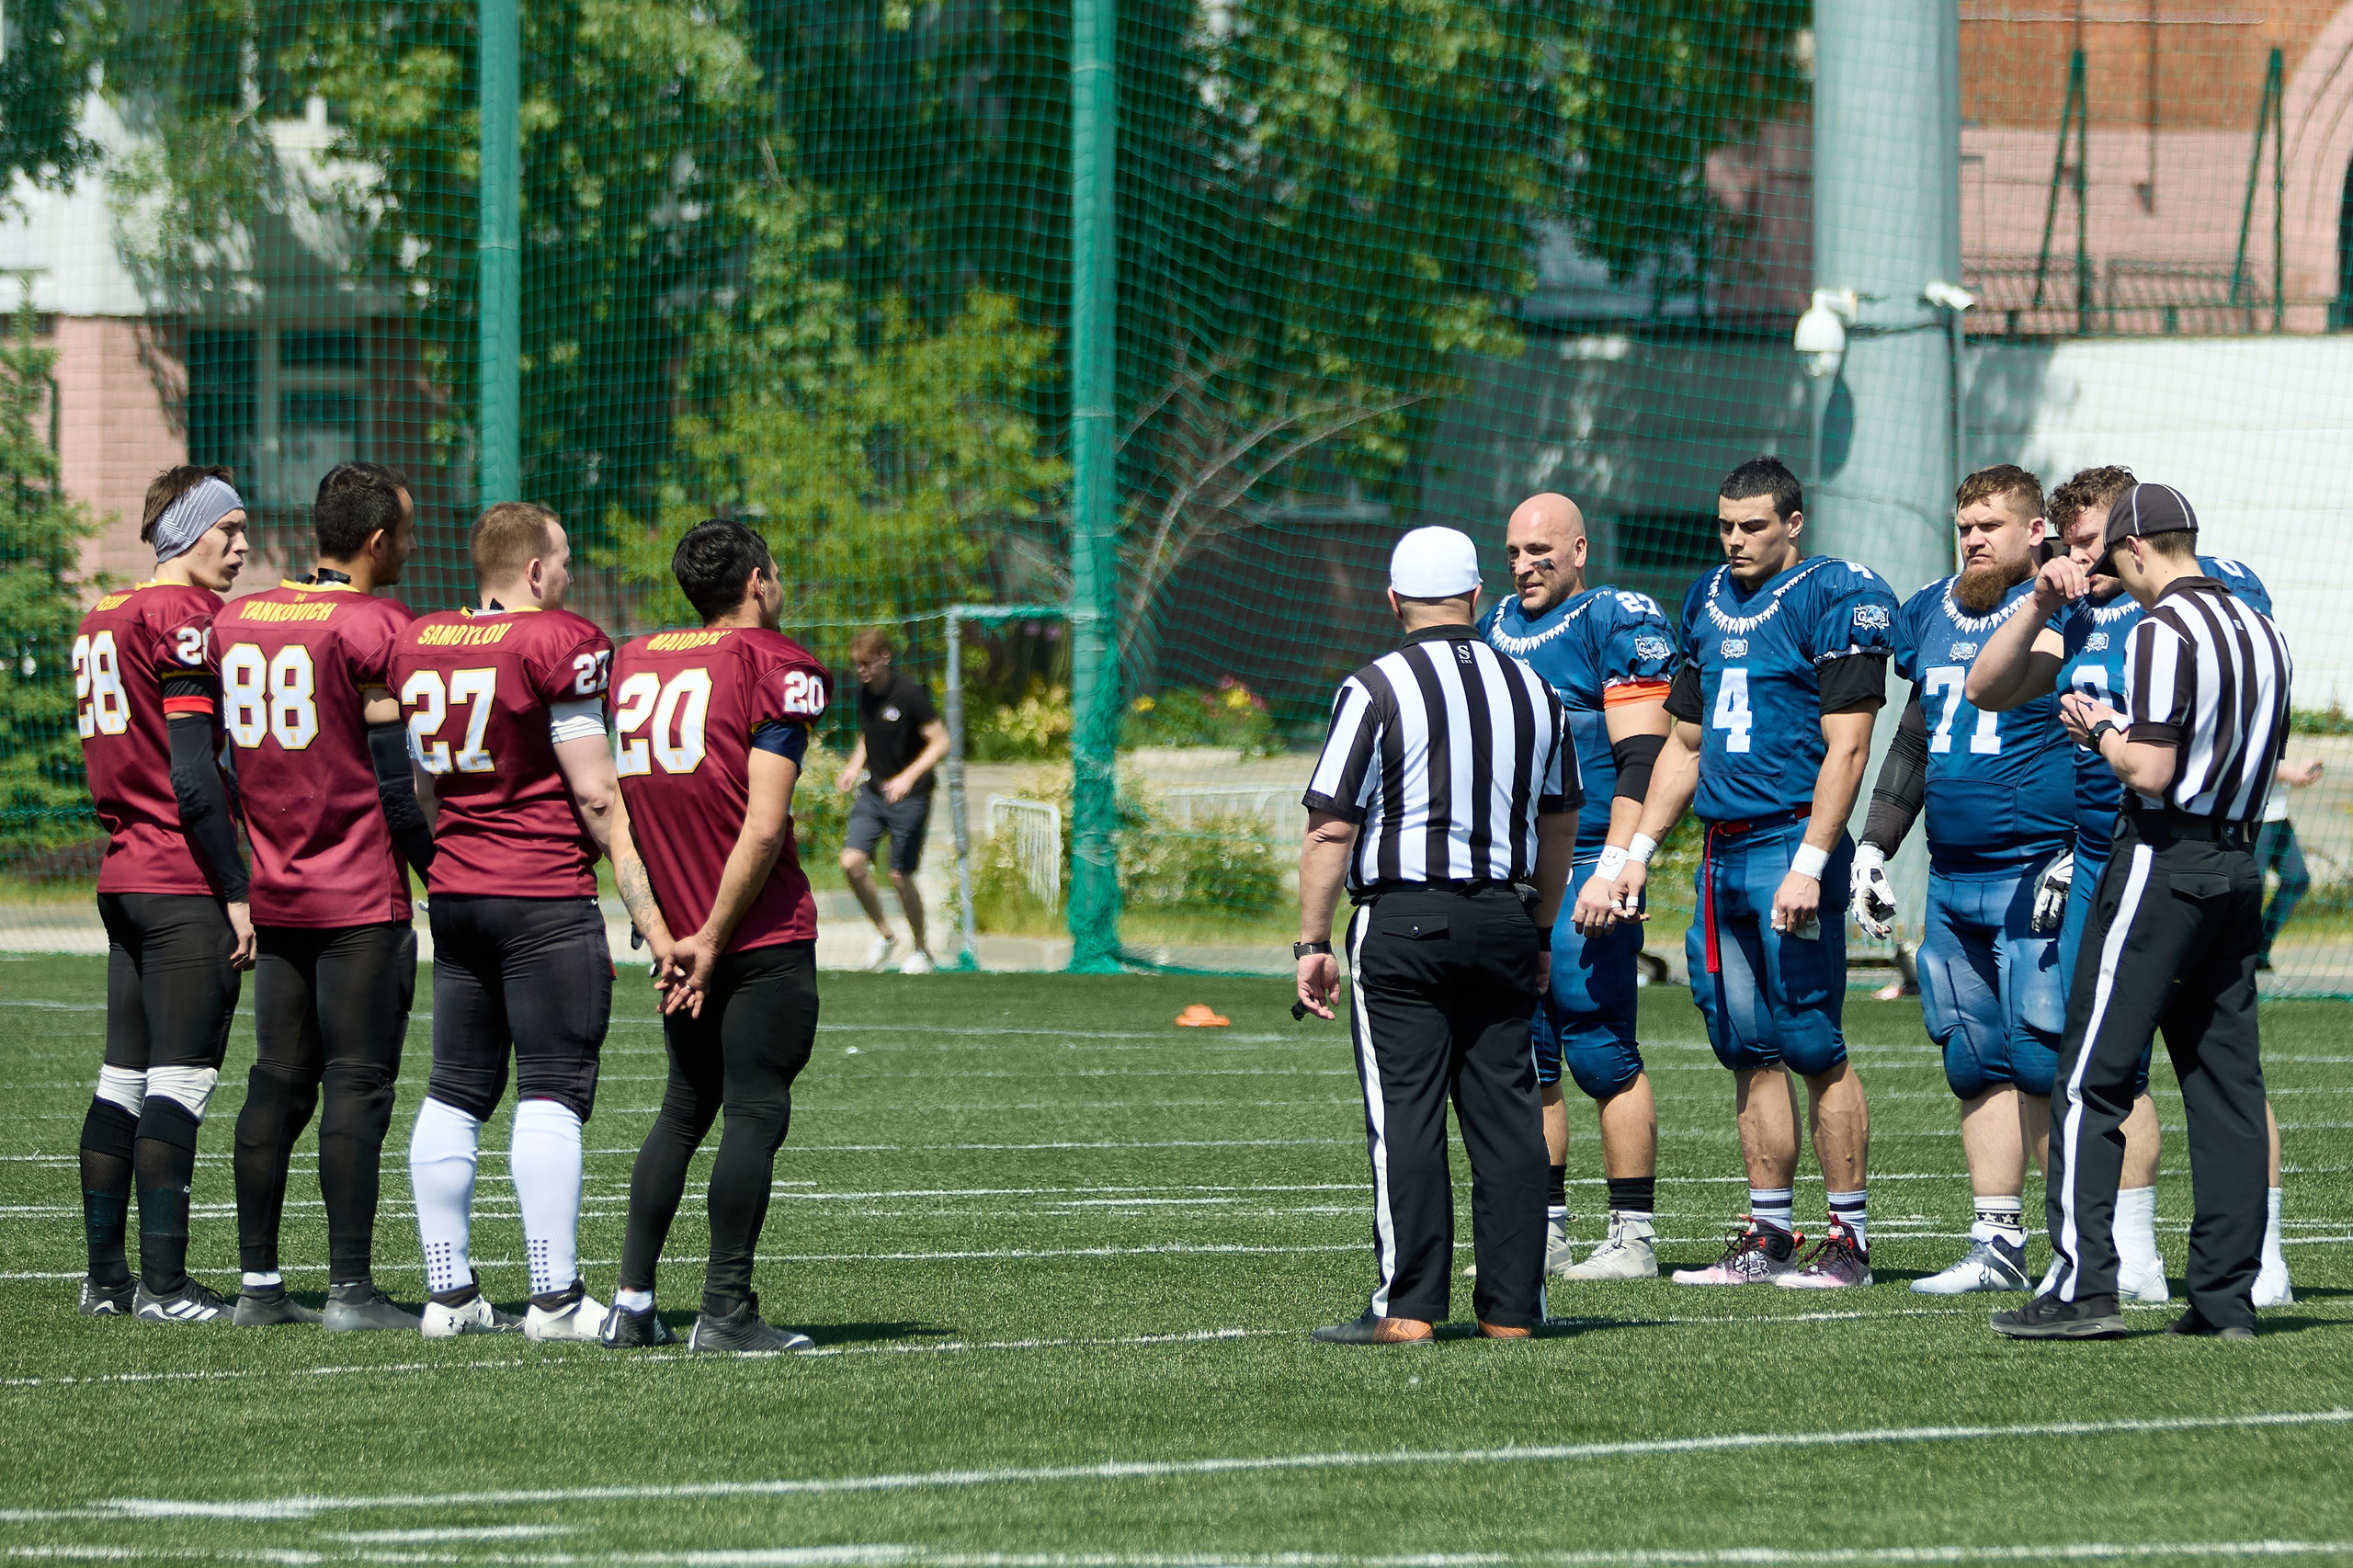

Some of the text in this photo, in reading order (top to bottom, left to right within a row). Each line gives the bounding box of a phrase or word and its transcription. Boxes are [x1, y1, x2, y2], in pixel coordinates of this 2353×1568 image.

[240, 600, 337, 622] YANKOVICH
[418, 623, 513, 645] SAMOYLOV
[73, 630, 131, 739] 28
[222, 642, 320, 750] 88
[573, 650, 610, 695] 27
[784, 671, 825, 715] 20
[1712, 668, 1754, 753] 4
[402, 667, 497, 775] 27
[617, 668, 712, 778] 20
